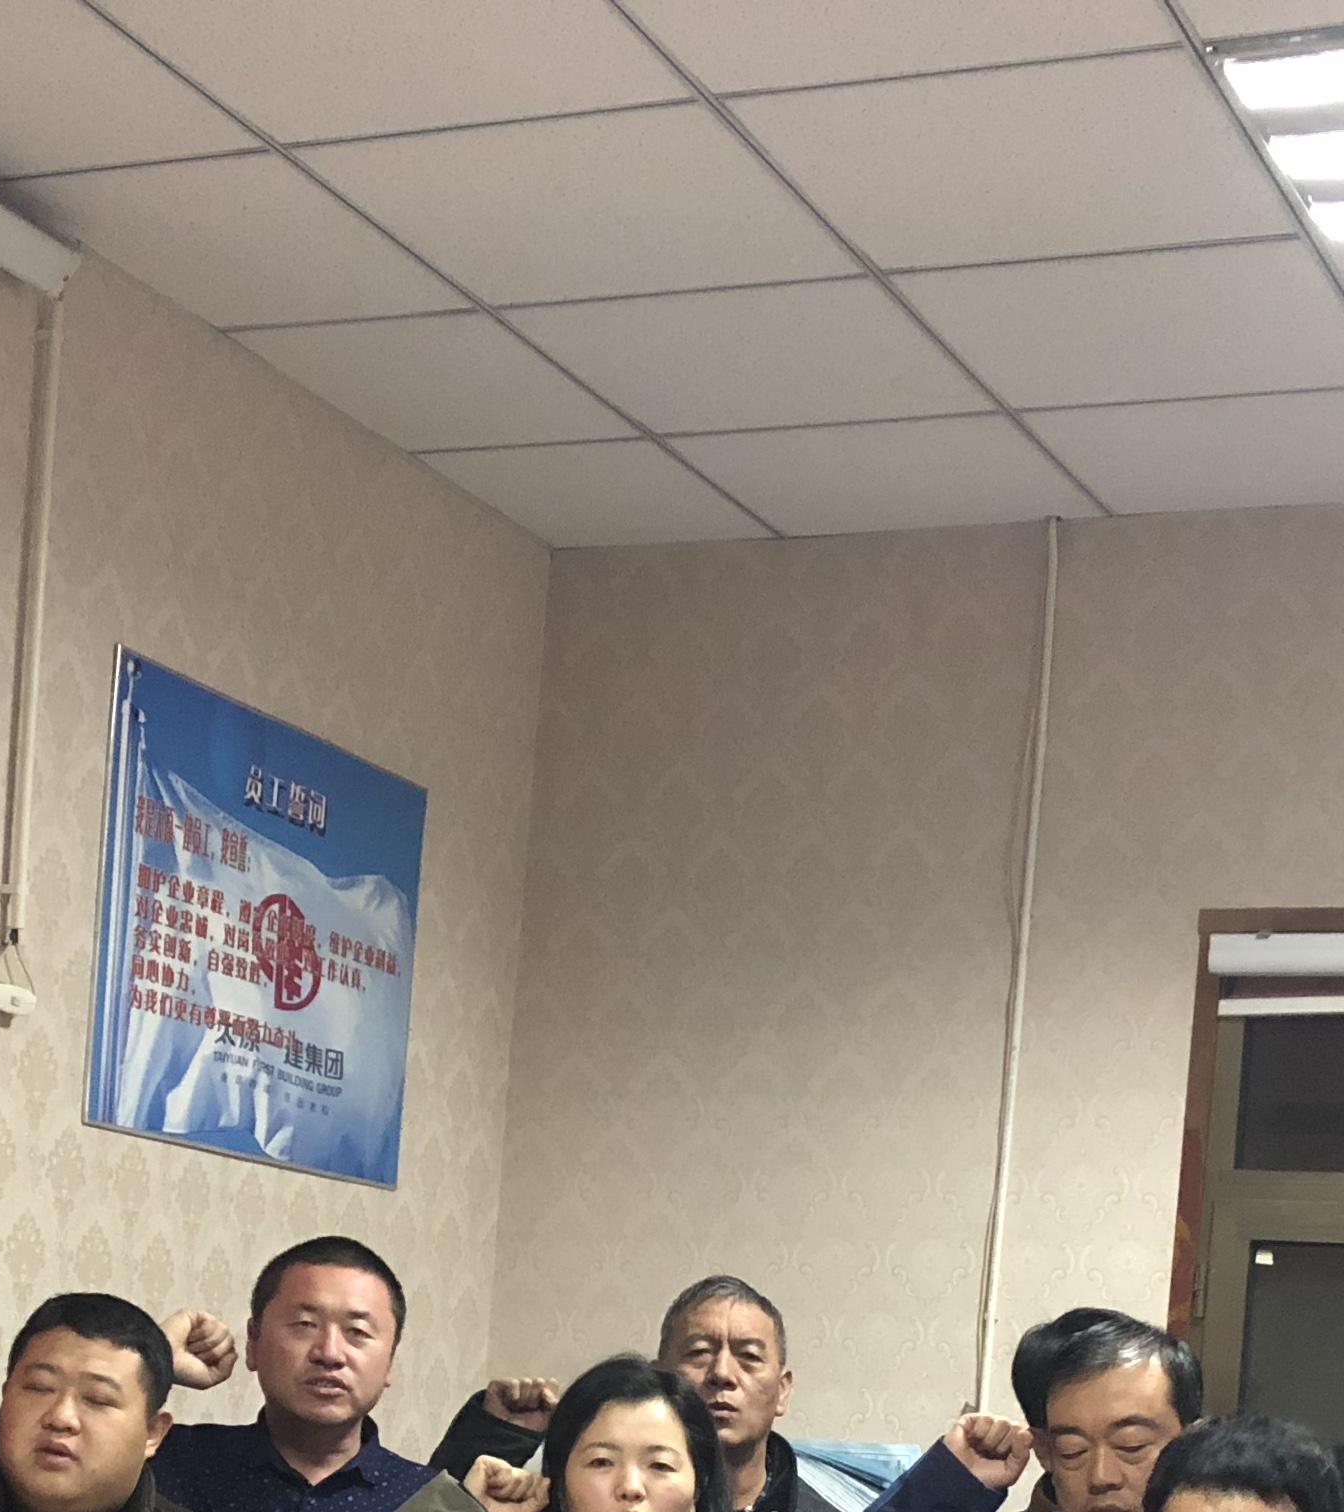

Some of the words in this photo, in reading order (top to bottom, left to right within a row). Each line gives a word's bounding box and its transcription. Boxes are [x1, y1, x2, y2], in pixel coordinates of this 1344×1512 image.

[244, 764, 327, 831] 员工誓词
[213, 1051, 249, 1067] TAIYUAN
[277, 1067, 315, 1092] BUILDING
[316, 1081, 344, 1098] GROUP
